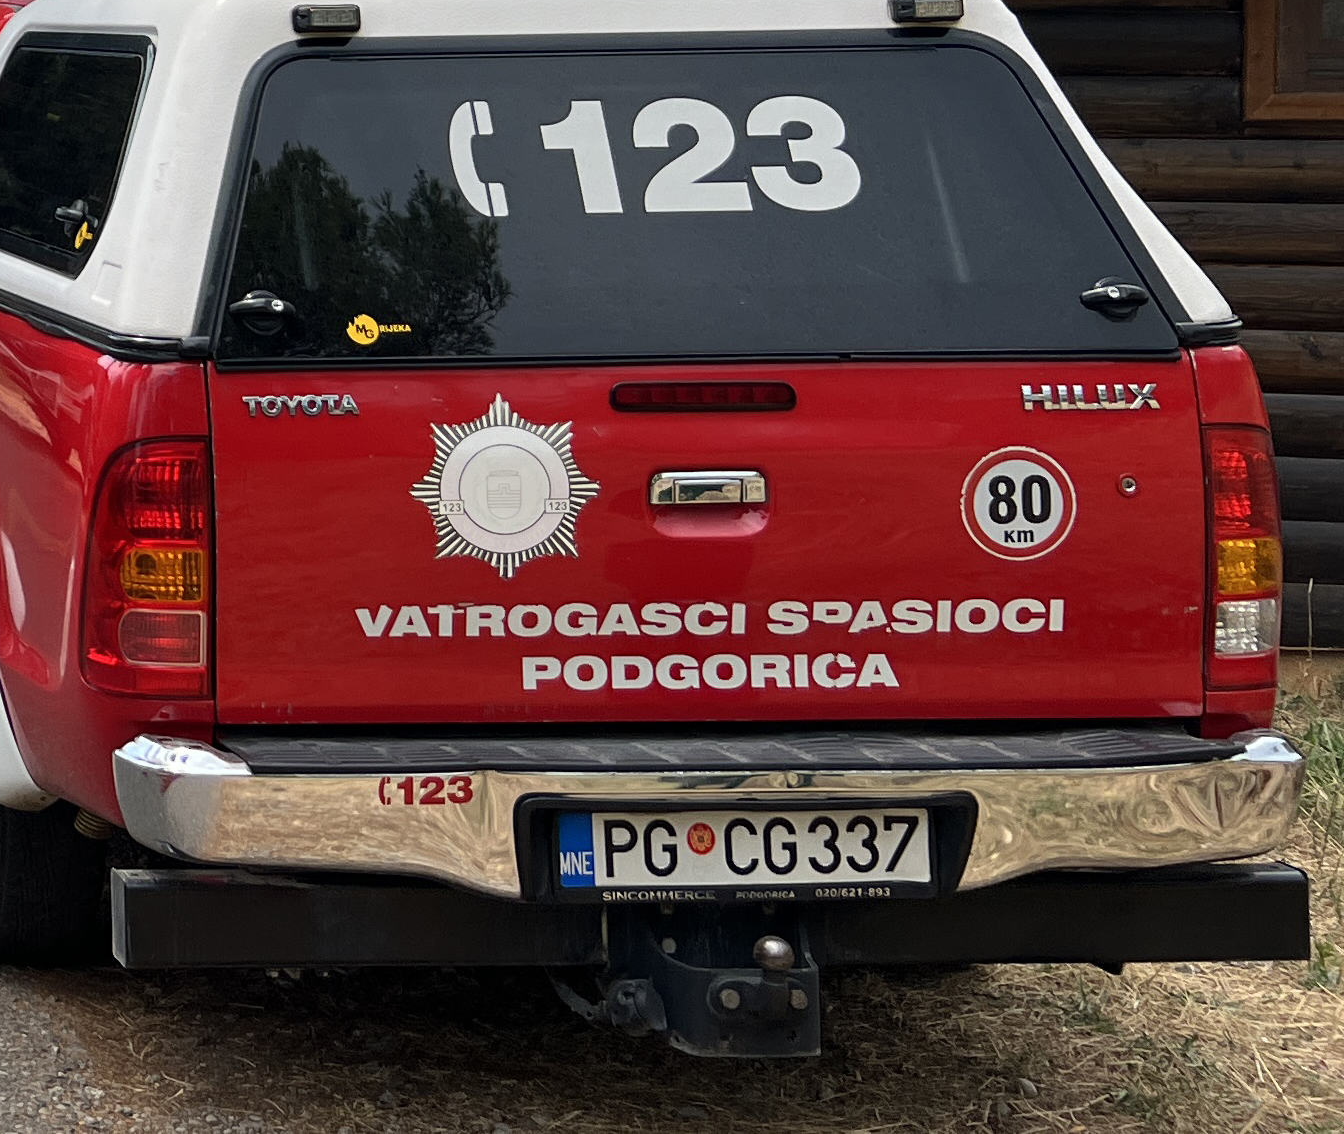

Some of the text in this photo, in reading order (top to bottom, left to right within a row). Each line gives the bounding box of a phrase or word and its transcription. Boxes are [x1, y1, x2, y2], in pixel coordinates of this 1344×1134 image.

[540, 95, 861, 214] 123
[379, 324, 411, 333] RIJEKA
[242, 394, 360, 417] TOYOTA
[1021, 383, 1161, 410] HILUX
[442, 502, 462, 513] 123
[549, 501, 568, 511] 123
[988, 474, 1052, 525] 80
[355, 598, 1065, 638] VATROGASCI SPASIOCI
[521, 652, 900, 691] PODGORICA
[397, 775, 473, 805] 123
[559, 815, 920, 879] MNE PG CG337
[602, 889, 716, 902] SINCOMMERCE
[735, 889, 797, 900] PODGORICA
